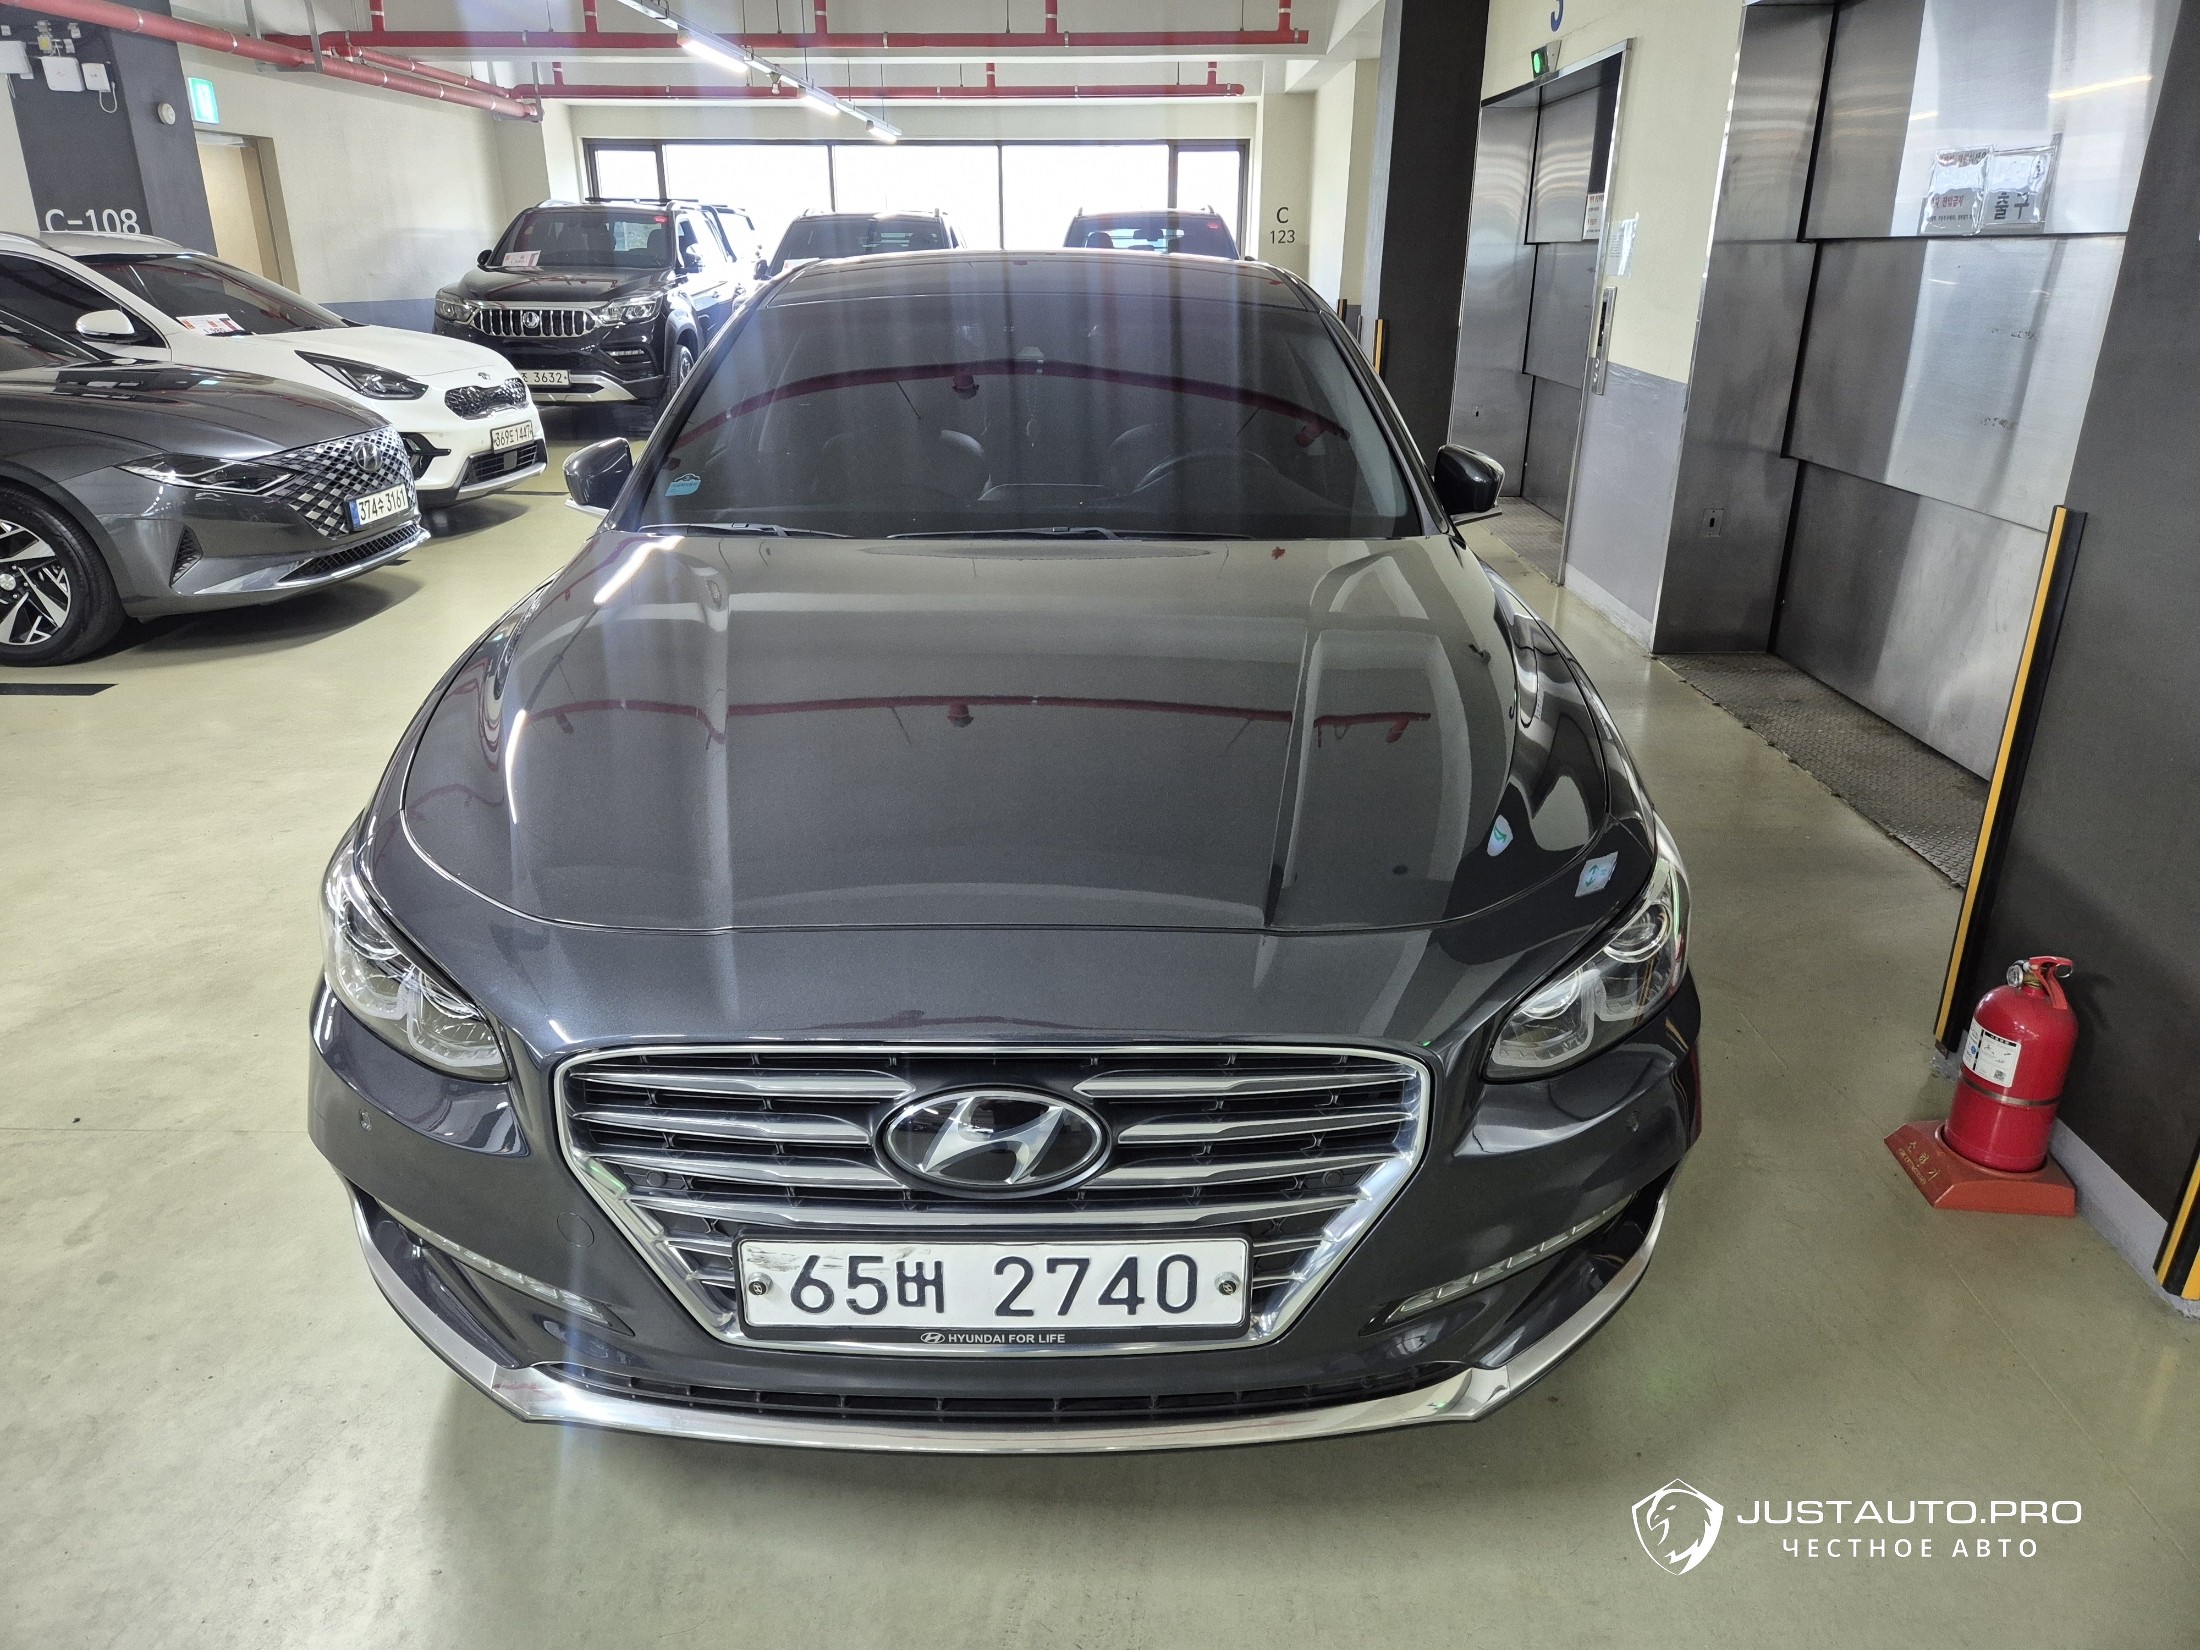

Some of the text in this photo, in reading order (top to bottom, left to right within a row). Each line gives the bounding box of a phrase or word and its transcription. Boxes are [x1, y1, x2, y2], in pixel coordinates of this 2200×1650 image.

[1994, 191, 2030, 220] 출구
[45, 208, 140, 234] C-108
[1276, 206, 1289, 224] C
[1270, 229, 1295, 244] 123
[533, 372, 563, 384] 3632
[515, 424, 530, 441] 1447
[359, 488, 406, 521] 374수 3161
[789, 1253, 1199, 1317] 65버 2740
[948, 1333, 1066, 1344] HYUNDAI FOR LIFE
